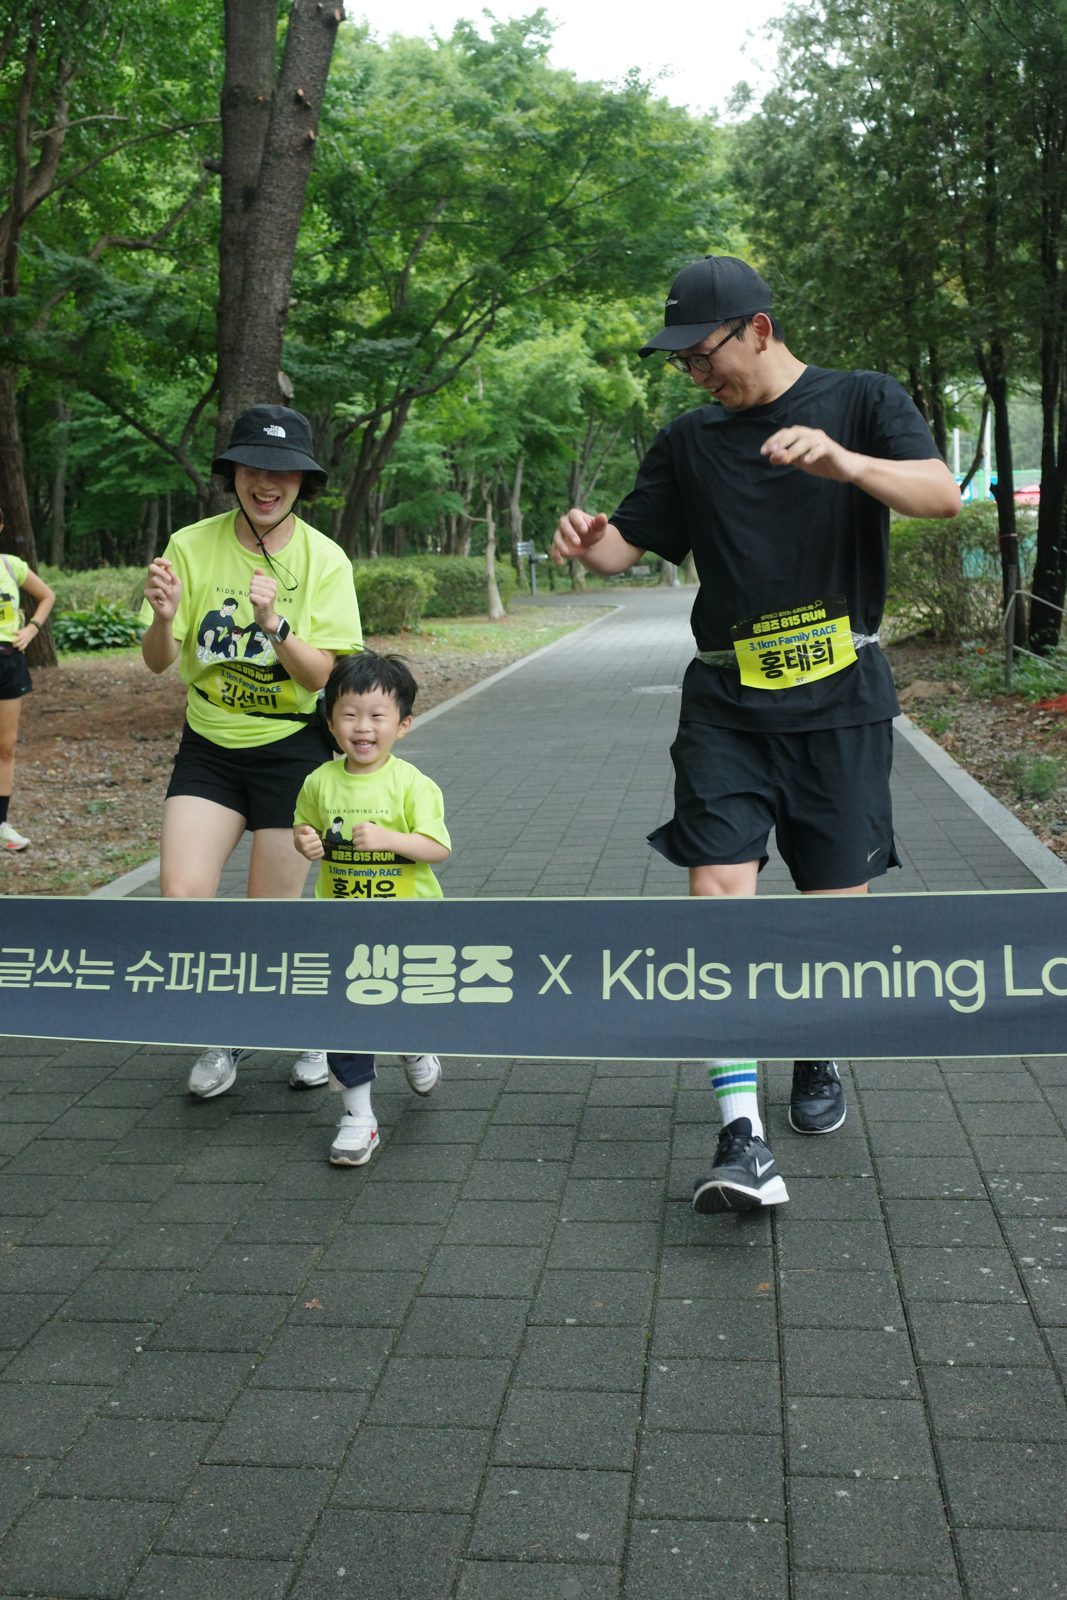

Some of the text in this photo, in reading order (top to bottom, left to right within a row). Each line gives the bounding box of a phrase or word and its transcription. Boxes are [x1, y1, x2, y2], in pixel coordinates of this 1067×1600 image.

[781, 614, 800, 628] 815
[801, 608, 827, 624] RUN
[749, 624, 837, 652] 3.1km Family RACE
[759, 637, 834, 679] 홍태희
[255, 671, 274, 682] RUN
[221, 681, 278, 709] 김선미
[260, 685, 282, 693] RACE
[353, 851, 371, 862] 815
[372, 851, 395, 862] RUN
[348, 868, 377, 878] Family
[380, 867, 402, 876] RACE
[0, 948, 115, 991] 글쓰는
[124, 950, 332, 995] 슈퍼러너들
[345, 943, 514, 1005] 생글즈
[602, 946, 733, 1001] Kids
[748, 944, 986, 1014] running
